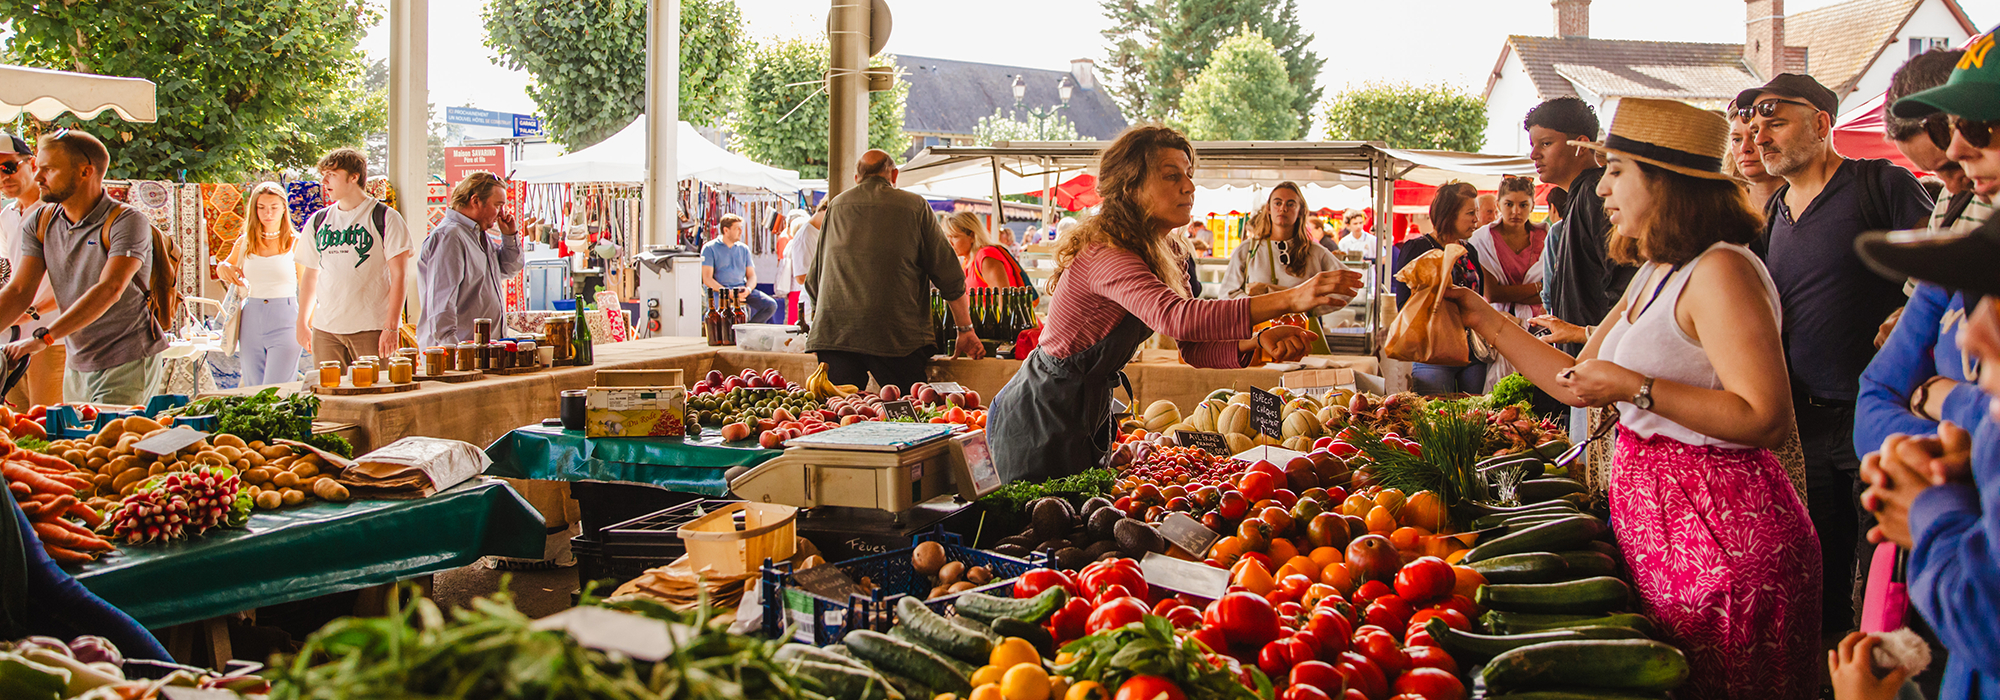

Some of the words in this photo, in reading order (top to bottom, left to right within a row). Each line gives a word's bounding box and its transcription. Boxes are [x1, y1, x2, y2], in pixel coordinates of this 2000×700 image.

[453, 149, 471, 158] Maison
[471, 149, 496, 157] SAVARINO
[627, 420, 639, 428] Du
[845, 537, 887, 553] Fèves
